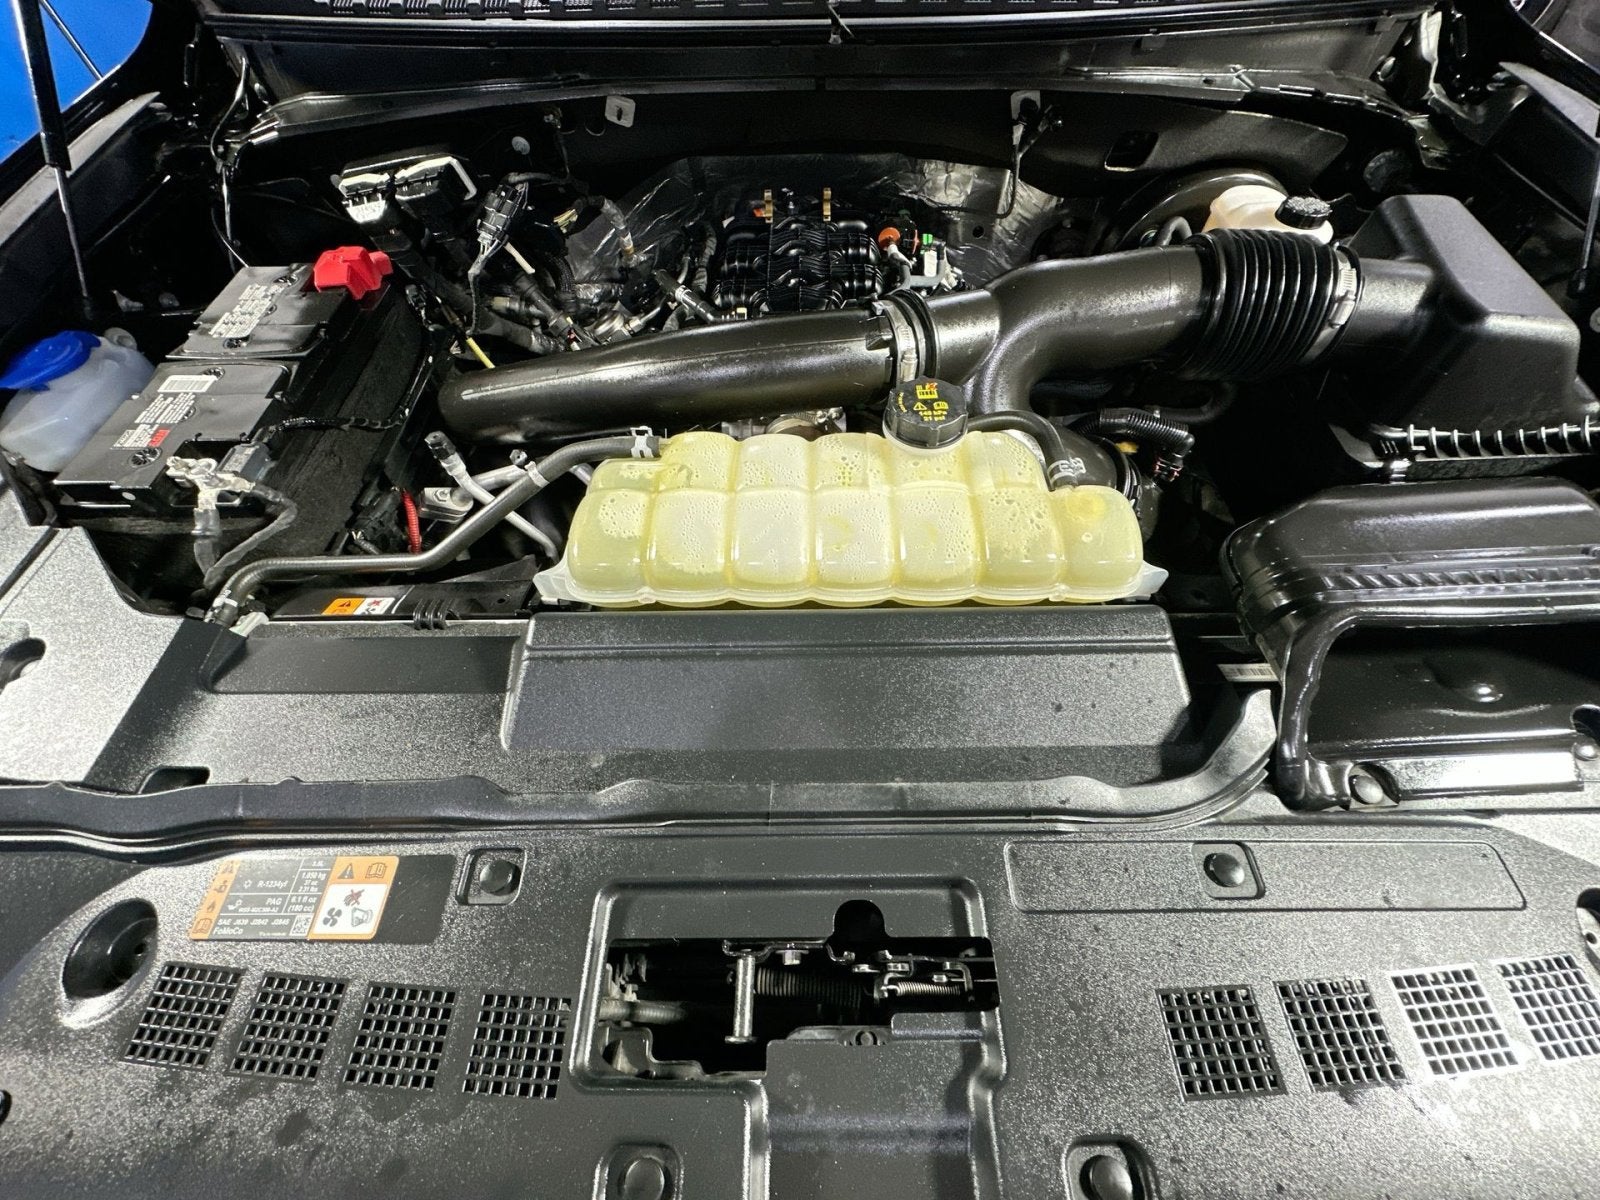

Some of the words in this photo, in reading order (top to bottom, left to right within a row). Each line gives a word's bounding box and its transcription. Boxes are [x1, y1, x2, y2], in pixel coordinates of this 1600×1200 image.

[318, 871, 327, 880] kg
[257, 880, 288, 889] R-1234yf
[265, 897, 283, 906] PAG
[287, 904, 303, 912] (180
[303, 904, 315, 912] cc)
[217, 918, 233, 926] SAE
[233, 918, 249, 926] J639
[212, 926, 244, 935] FoMoCo
